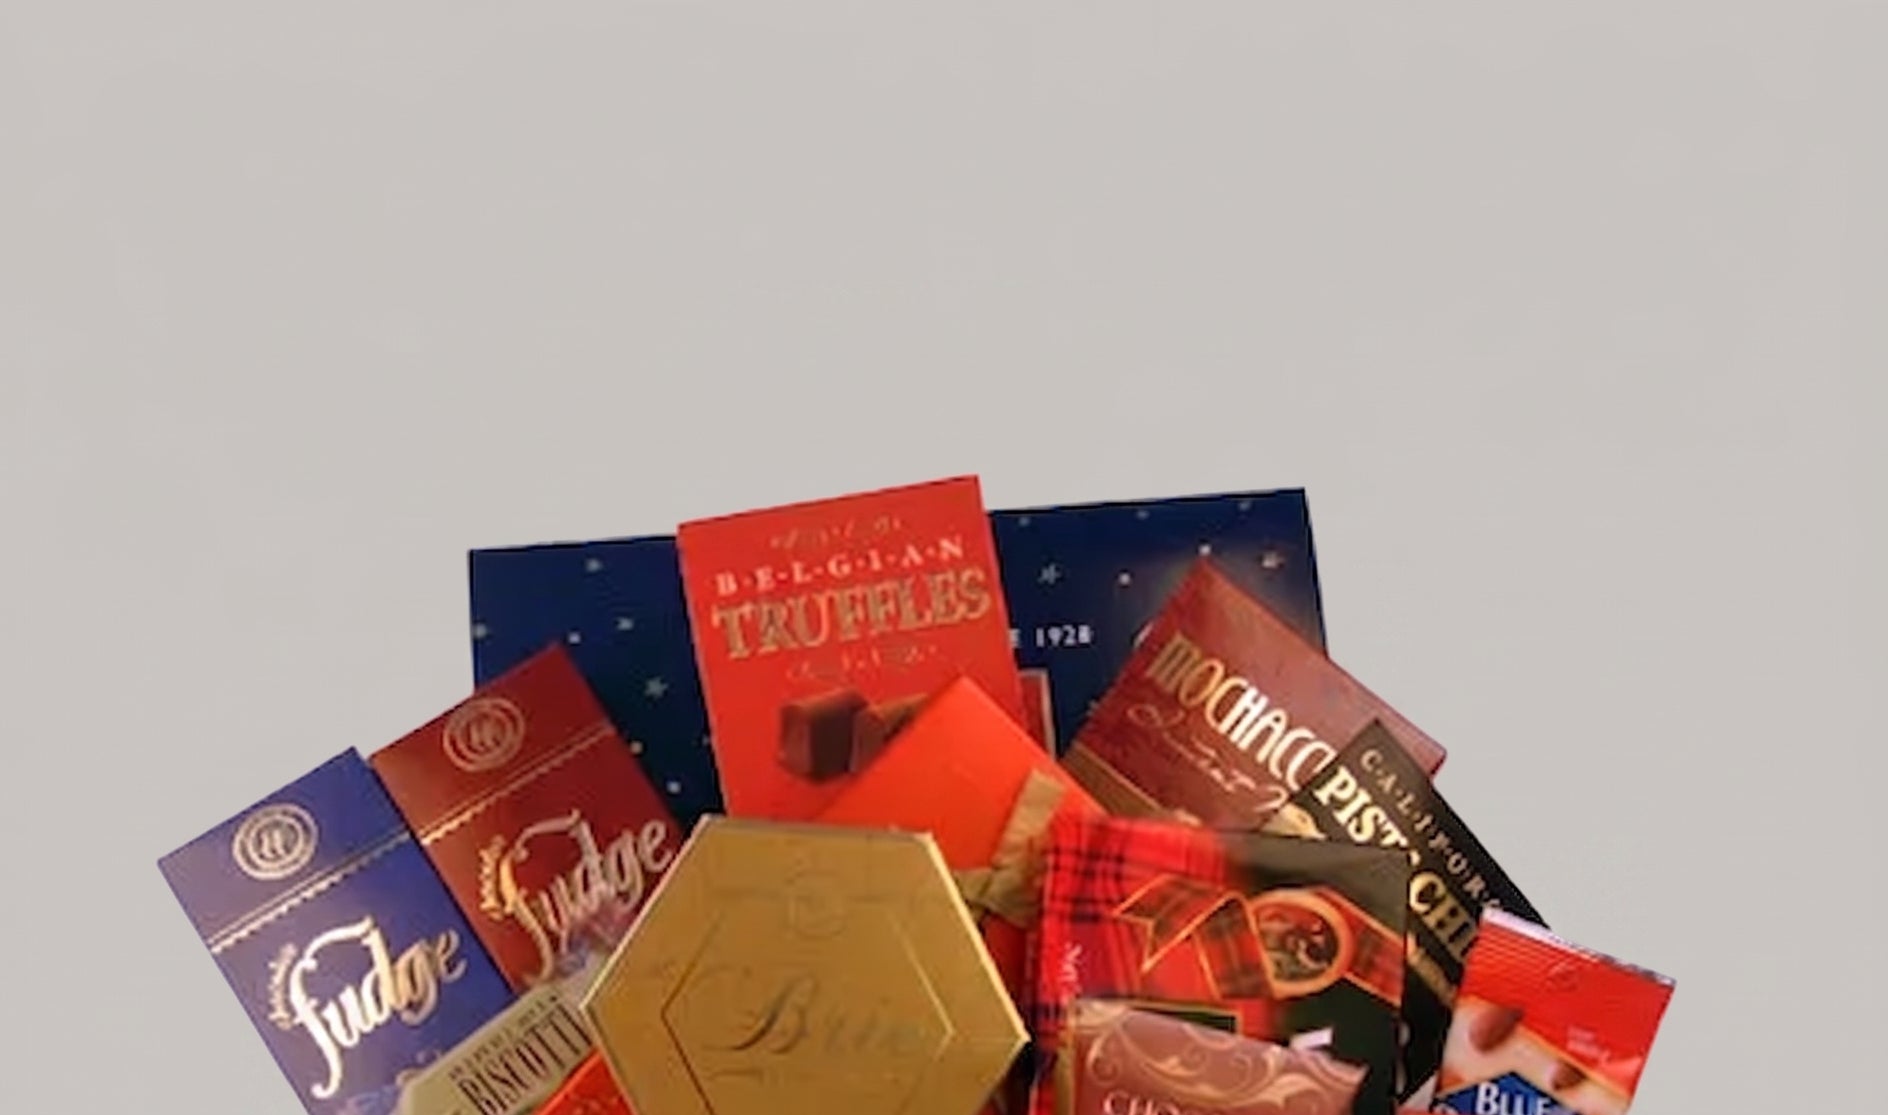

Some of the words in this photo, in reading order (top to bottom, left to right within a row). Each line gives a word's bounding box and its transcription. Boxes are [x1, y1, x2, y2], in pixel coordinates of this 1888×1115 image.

[711, 566, 992, 660] TRUFFLES
[1036, 624, 1094, 648] 1928
[499, 808, 673, 985] fudge
[290, 914, 468, 1098] fudge
